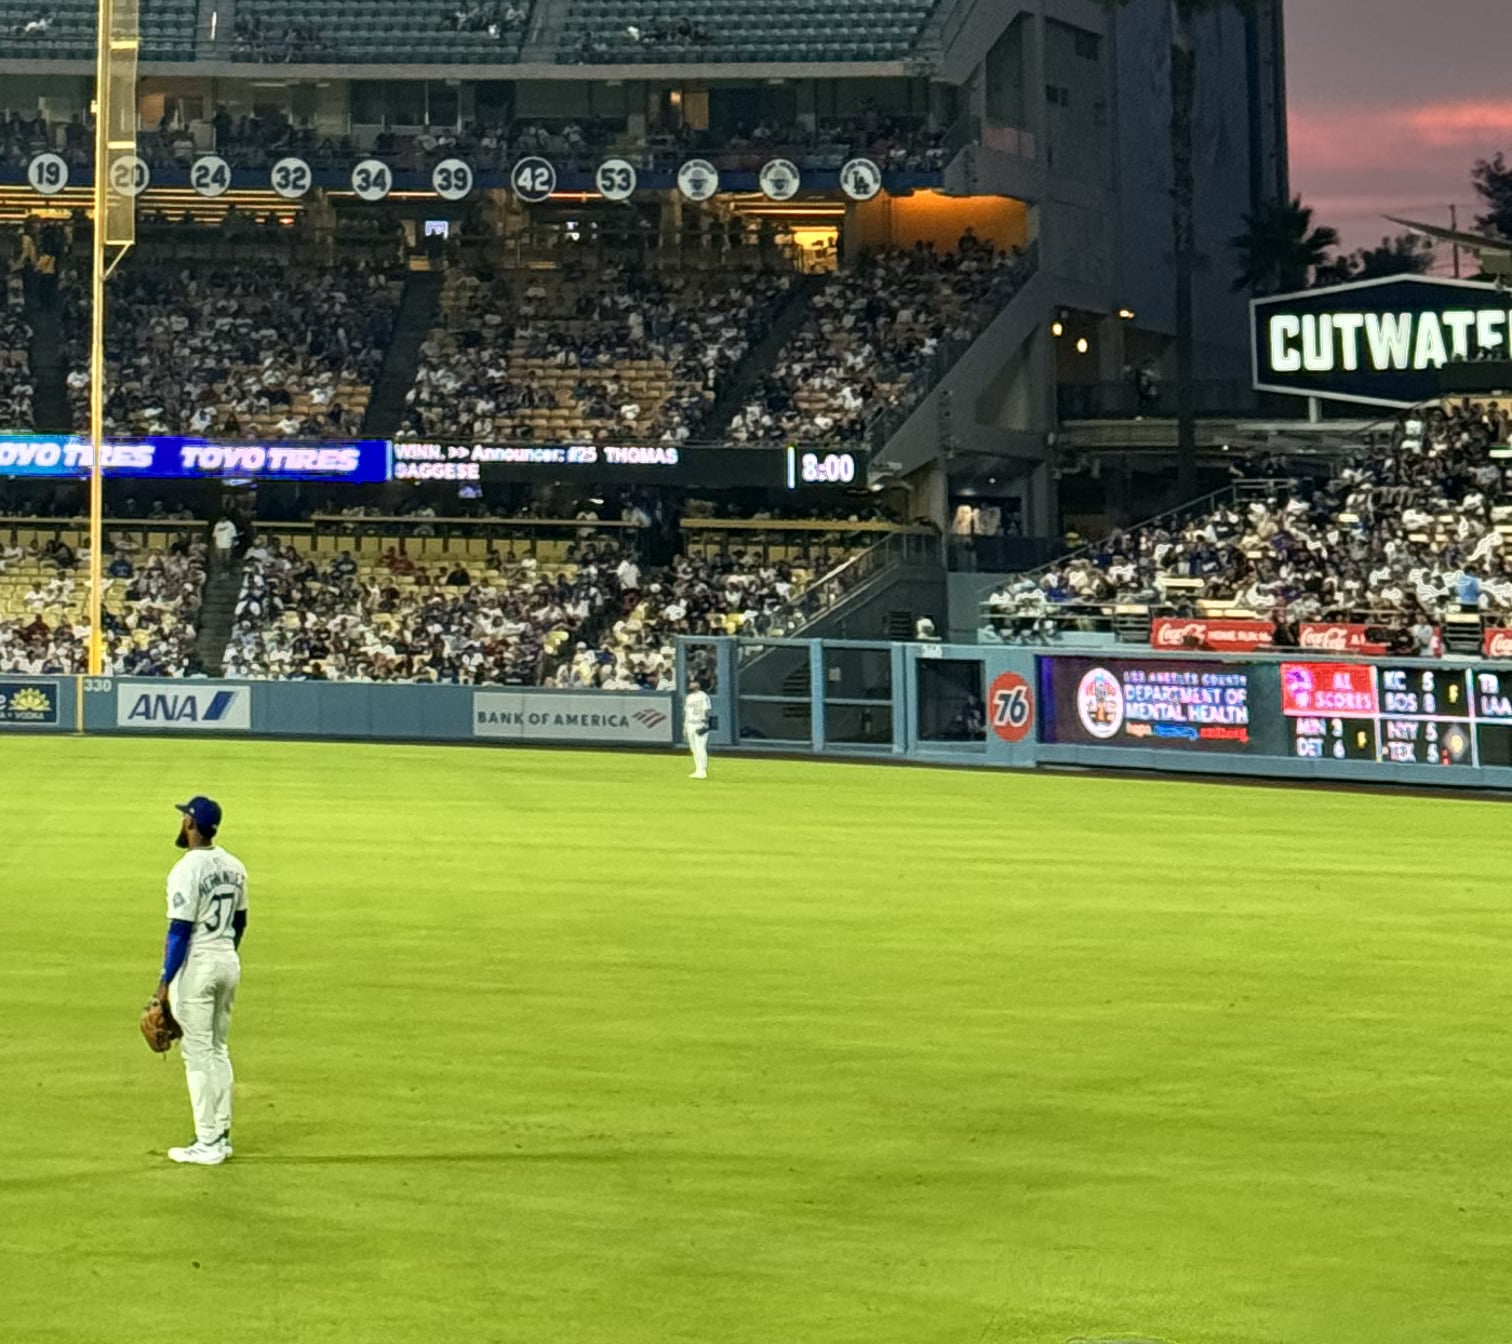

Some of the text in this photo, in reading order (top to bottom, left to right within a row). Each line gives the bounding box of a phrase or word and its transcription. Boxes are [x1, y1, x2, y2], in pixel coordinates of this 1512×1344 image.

[37, 162, 60, 185] 19
[115, 164, 144, 188] 20
[195, 165, 227, 188] 24
[276, 167, 307, 190] 32
[355, 168, 387, 191] 34
[438, 168, 469, 191] 39
[517, 167, 550, 191] 42
[600, 168, 632, 190] 53
[1270, 310, 1512, 372] CUTWATE
[180, 446, 361, 471] TOYO TIRES
[604, 446, 678, 464] THOMAS
[394, 463, 480, 480] SAGGESE
[802, 452, 855, 483] 8:00
[84, 679, 112, 692] 330
[1383, 670, 1407, 690] KC
[993, 685, 1029, 727] 76
[1124, 684, 1247, 705] DEPARTMENT OF
[1314, 691, 1372, 710] SCORES
[1385, 692, 1418, 712] BOS
[128, 693, 198, 722] ANA
[1125, 702, 1249, 724] MENTAL HEALTH
[478, 711, 630, 728] BANK OF AMERICA
[1296, 737, 1346, 759] DET 6
